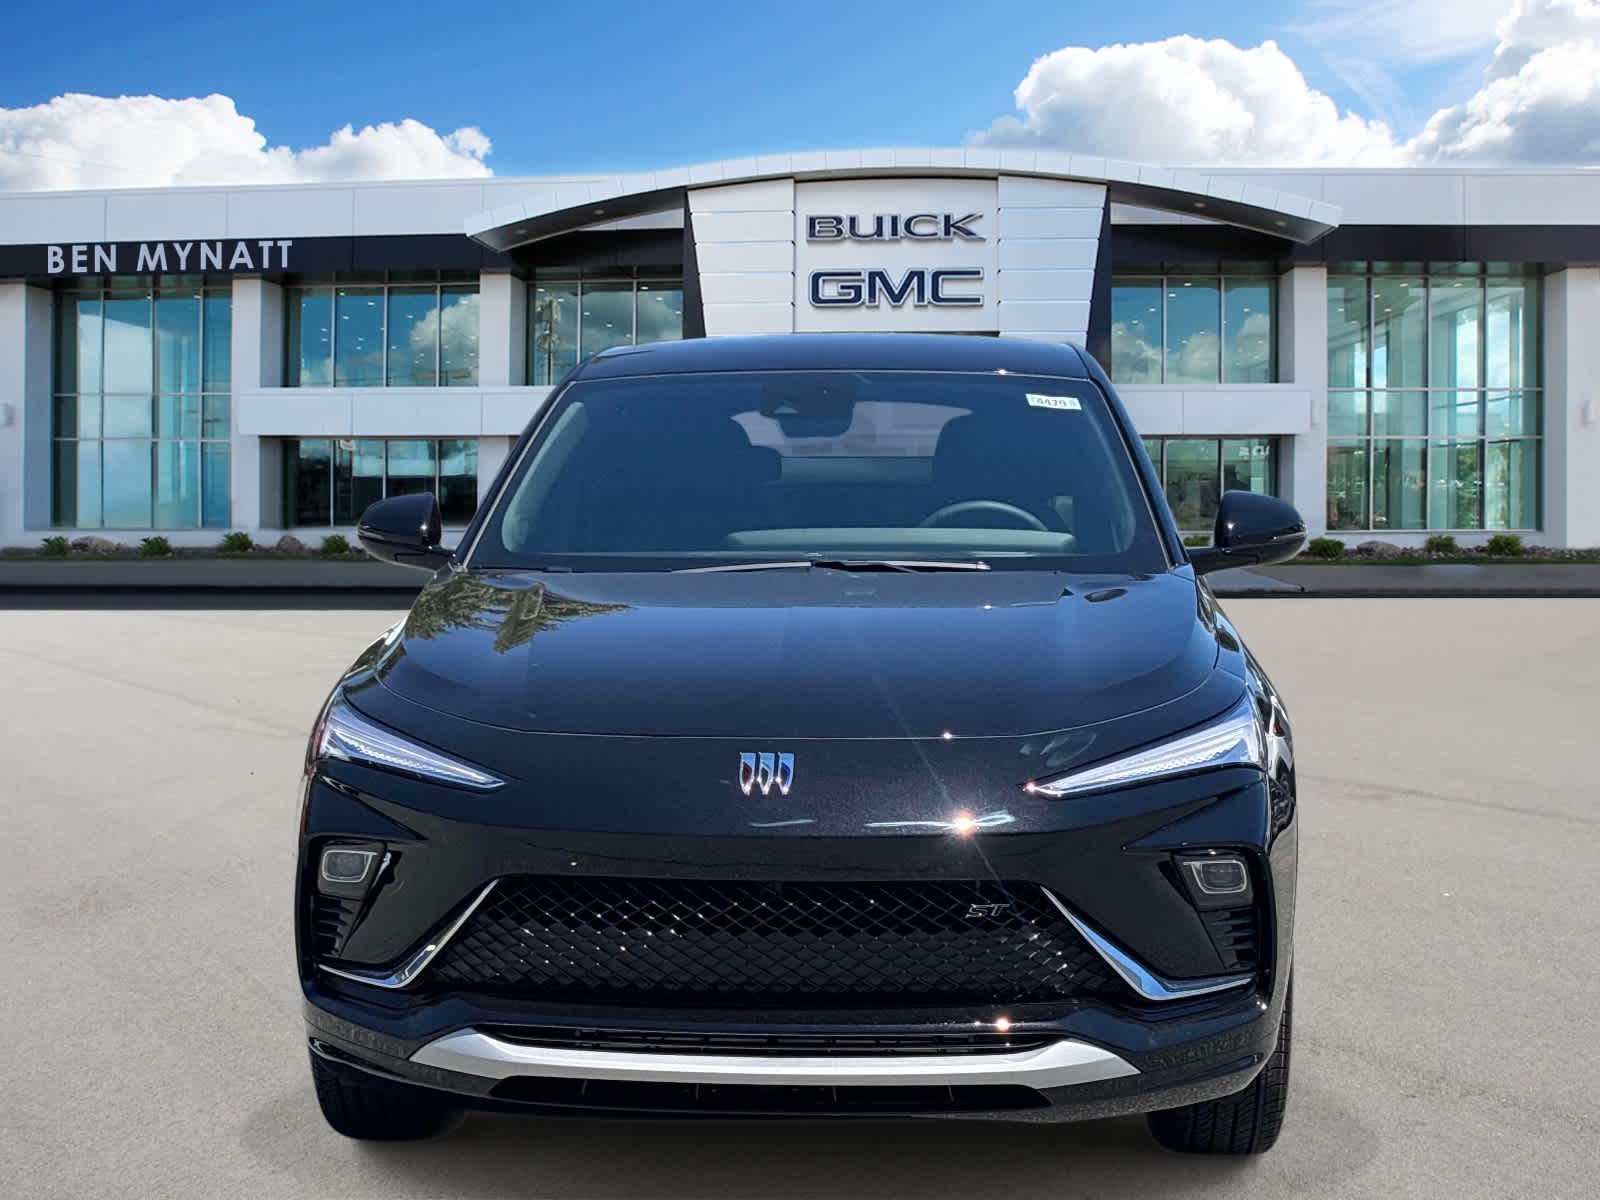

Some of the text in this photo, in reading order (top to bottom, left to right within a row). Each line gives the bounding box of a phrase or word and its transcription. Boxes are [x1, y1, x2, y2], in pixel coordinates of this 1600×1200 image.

[806, 213, 986, 241] BUICK
[47, 240, 293, 274] BEN MYNATT
[808, 267, 984, 308] GMC
[965, 903, 1010, 919] ST
